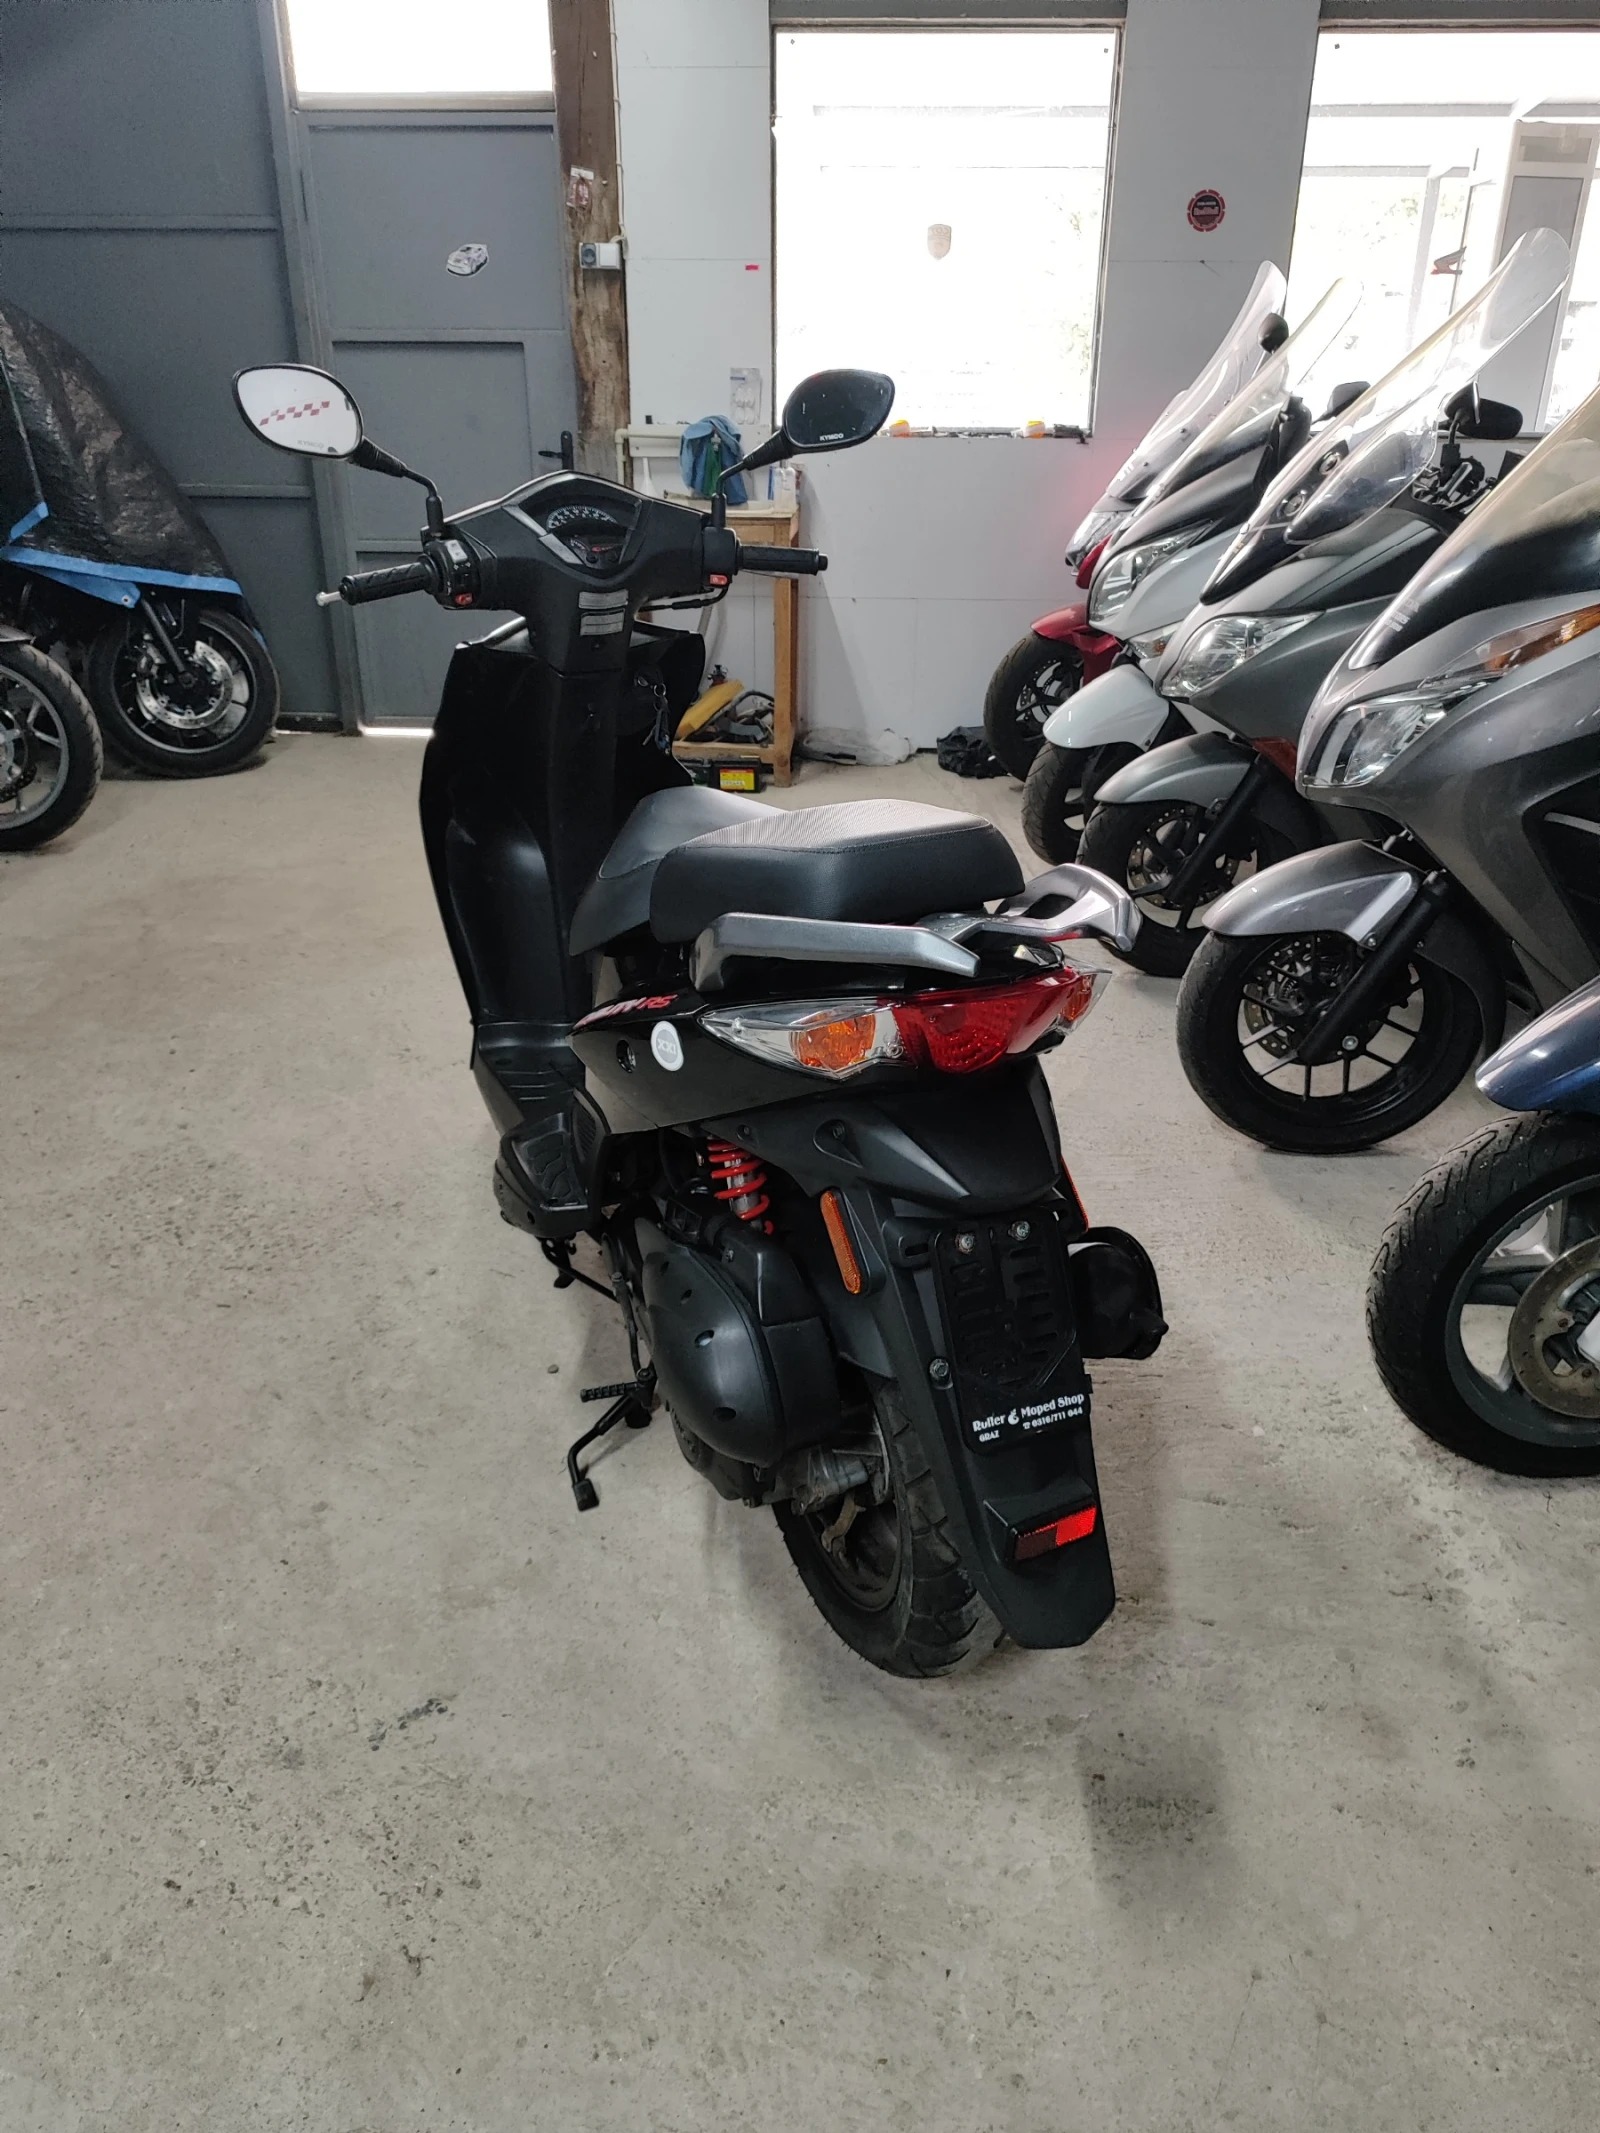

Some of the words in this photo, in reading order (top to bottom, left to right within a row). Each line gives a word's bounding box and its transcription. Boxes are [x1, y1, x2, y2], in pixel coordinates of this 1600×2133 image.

[819, 433, 844, 441] KYMCO
[1021, 1399, 1056, 1418] Moped
[1057, 1393, 1084, 1407] Shop
[979, 1430, 1000, 1442] GRAZ
[1067, 1406, 1083, 1417] 044
